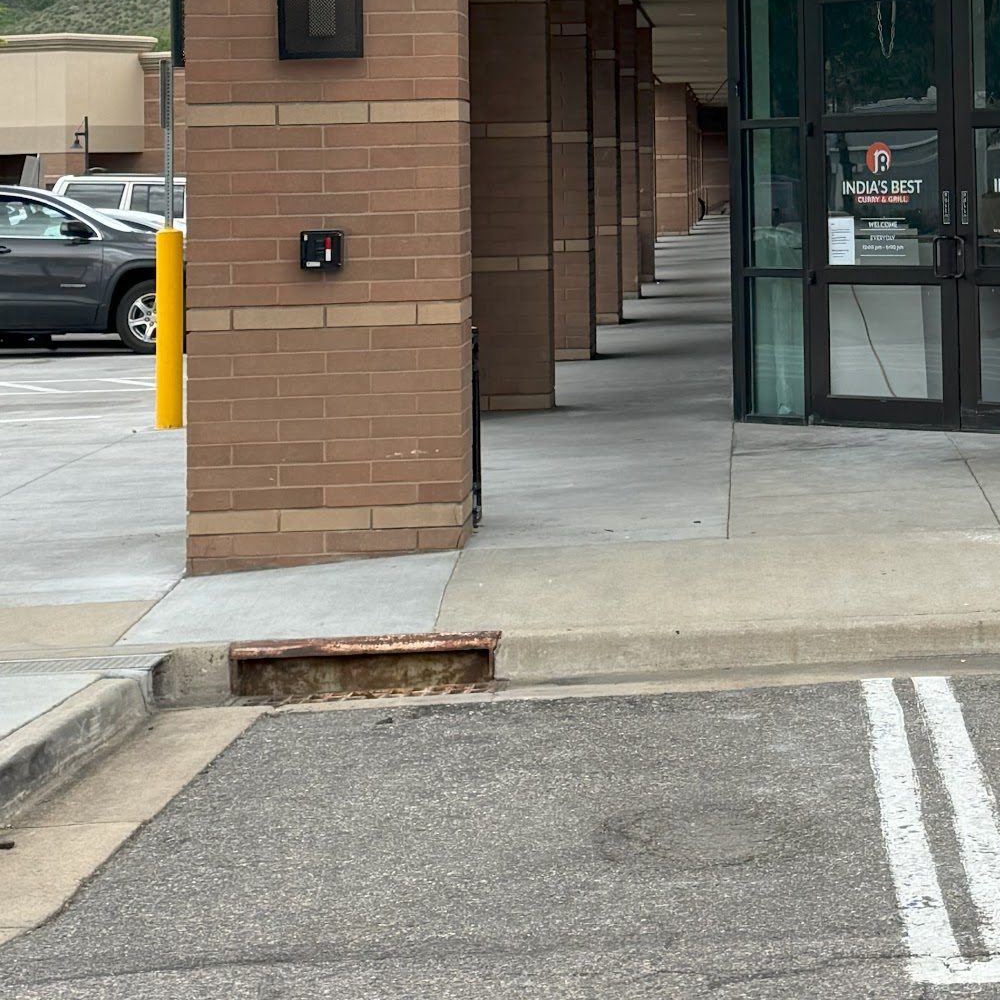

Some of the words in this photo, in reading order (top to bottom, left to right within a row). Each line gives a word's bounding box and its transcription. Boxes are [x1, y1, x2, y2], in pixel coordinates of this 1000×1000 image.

[842, 180, 888, 195] INDIA'S
[891, 179, 923, 194] BEST
[888, 195, 909, 203] GRILL
